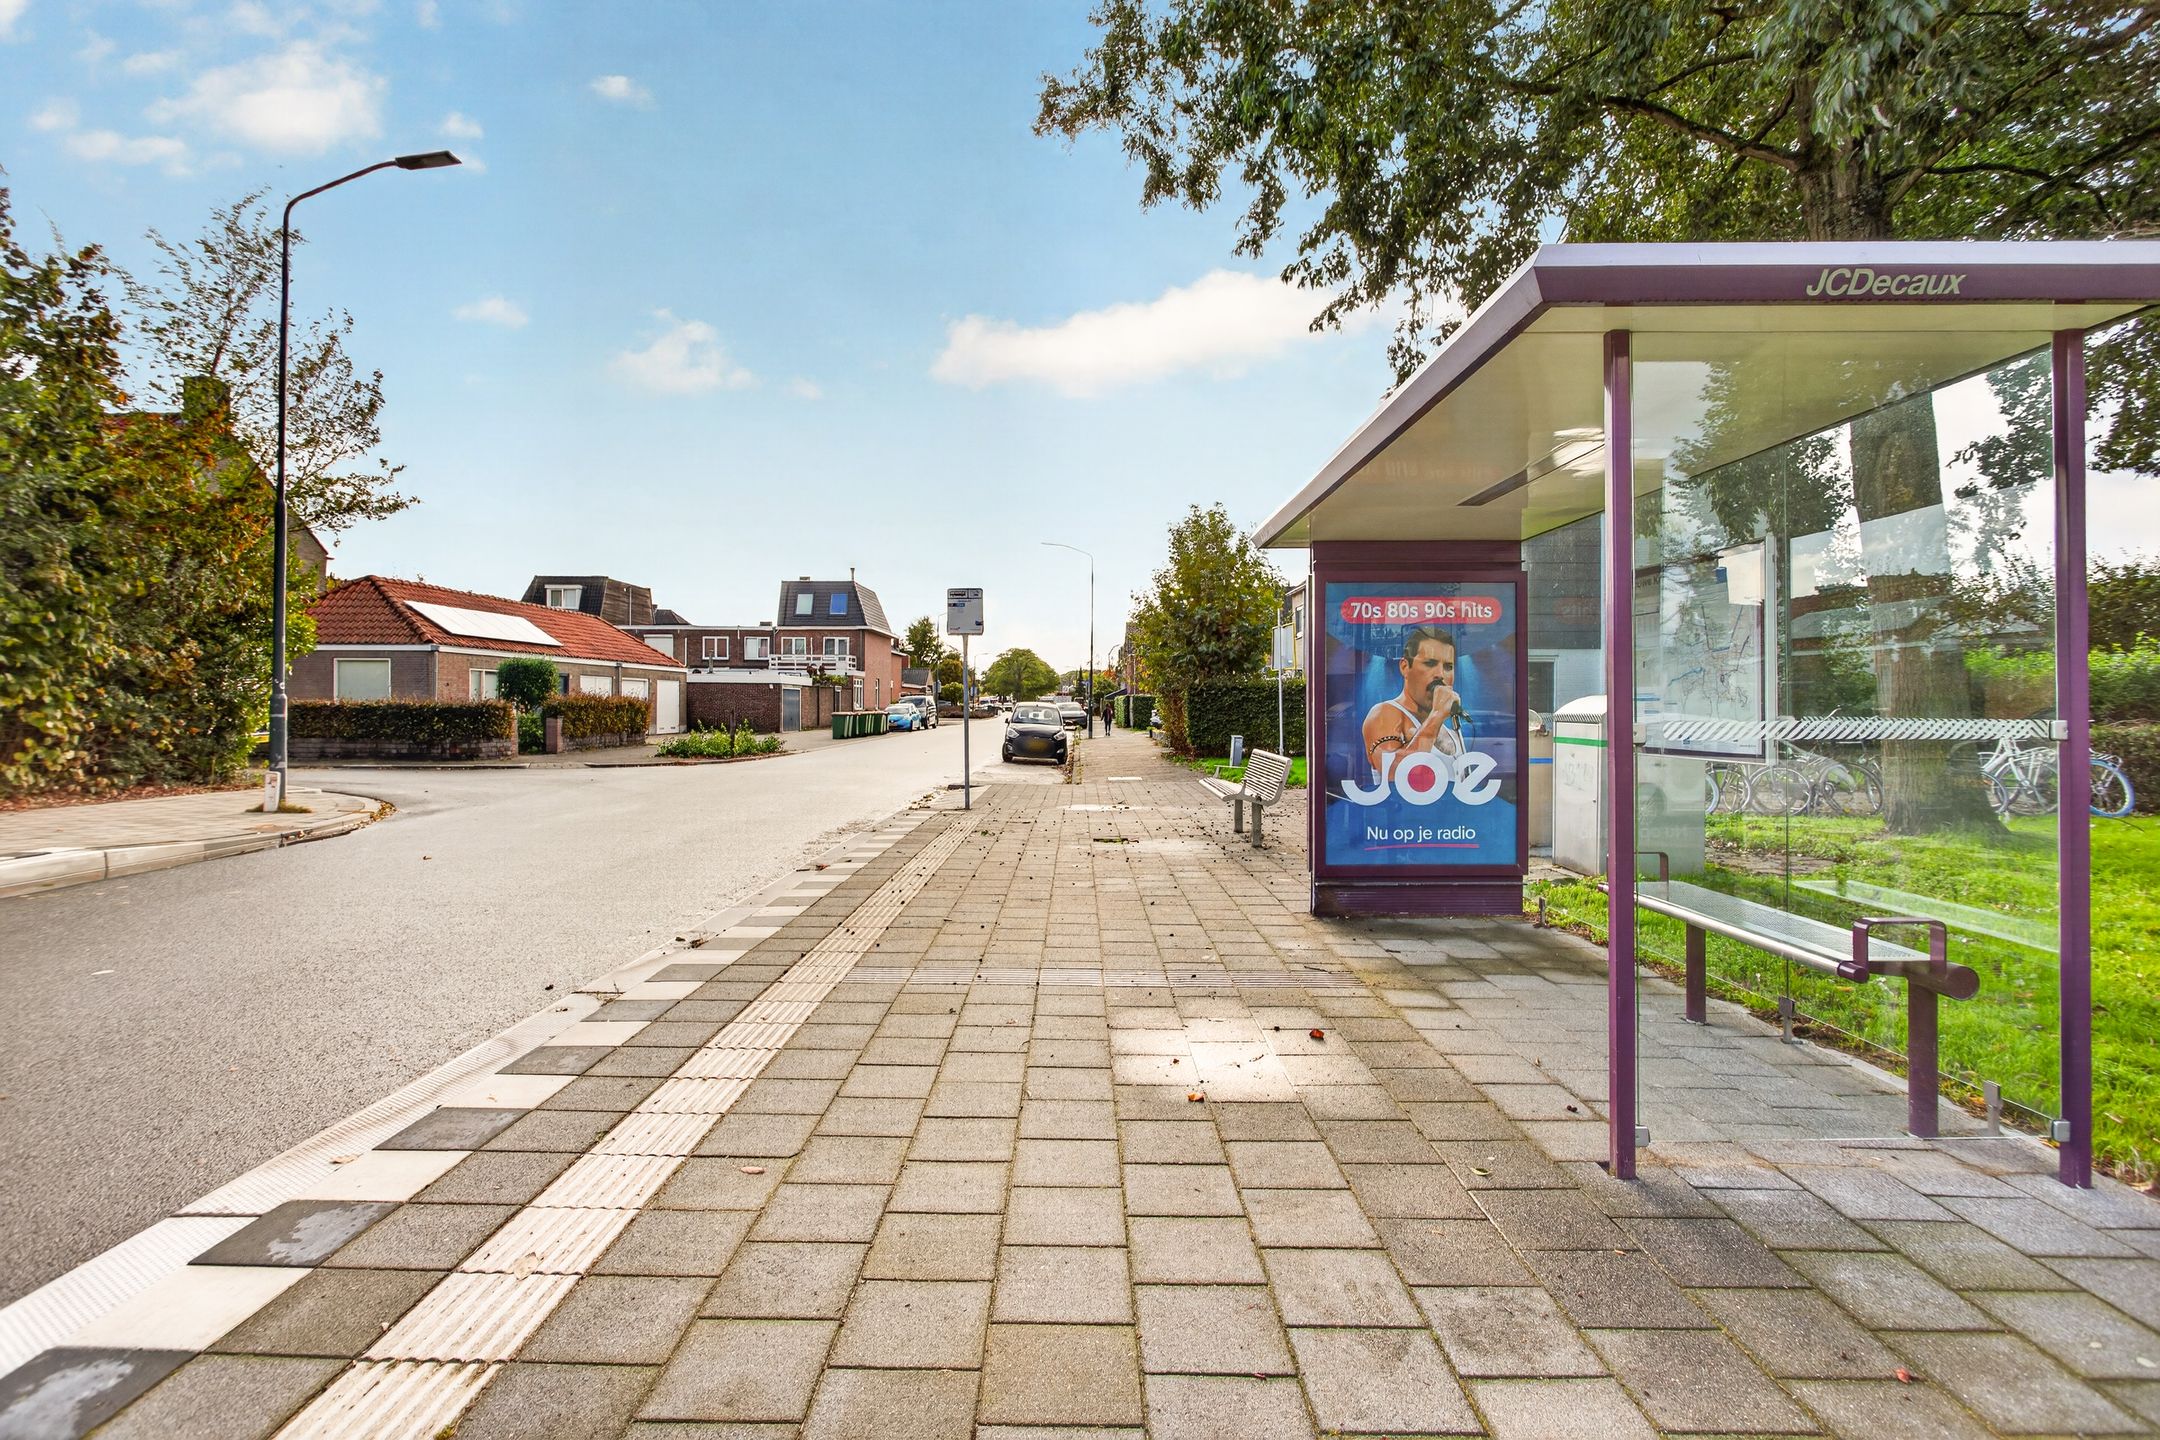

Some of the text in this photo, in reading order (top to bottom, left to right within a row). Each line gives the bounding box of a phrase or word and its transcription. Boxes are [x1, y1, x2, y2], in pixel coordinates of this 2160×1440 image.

[1805, 267, 1967, 297] JCDecaux
[1350, 601, 1493, 619] 70s 80s 90s hits
[1366, 825, 1476, 843] Nu op je radio
